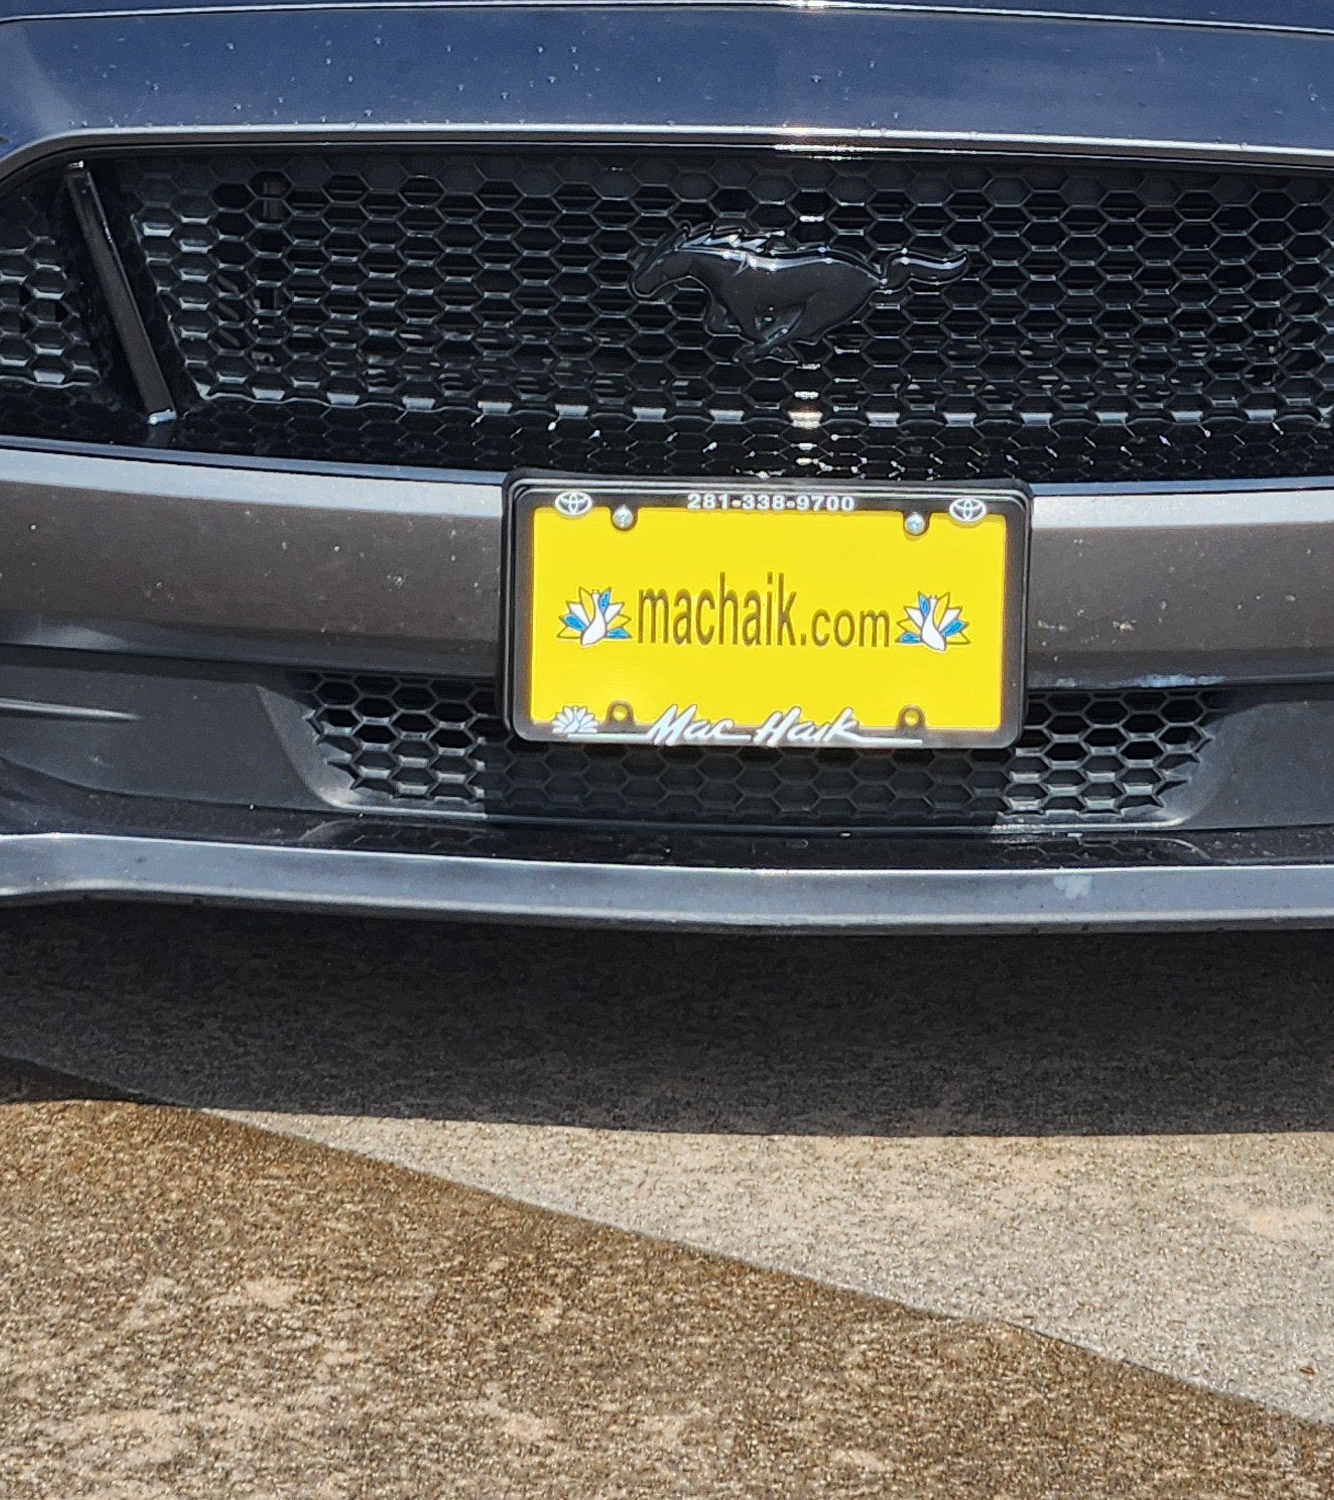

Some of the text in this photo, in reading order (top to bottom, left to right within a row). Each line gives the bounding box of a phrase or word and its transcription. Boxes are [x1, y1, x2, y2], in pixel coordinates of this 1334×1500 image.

[686, 493, 855, 513] 281-338-9700
[637, 570, 890, 648] machaik.com
[646, 703, 867, 748] Mac Haik
